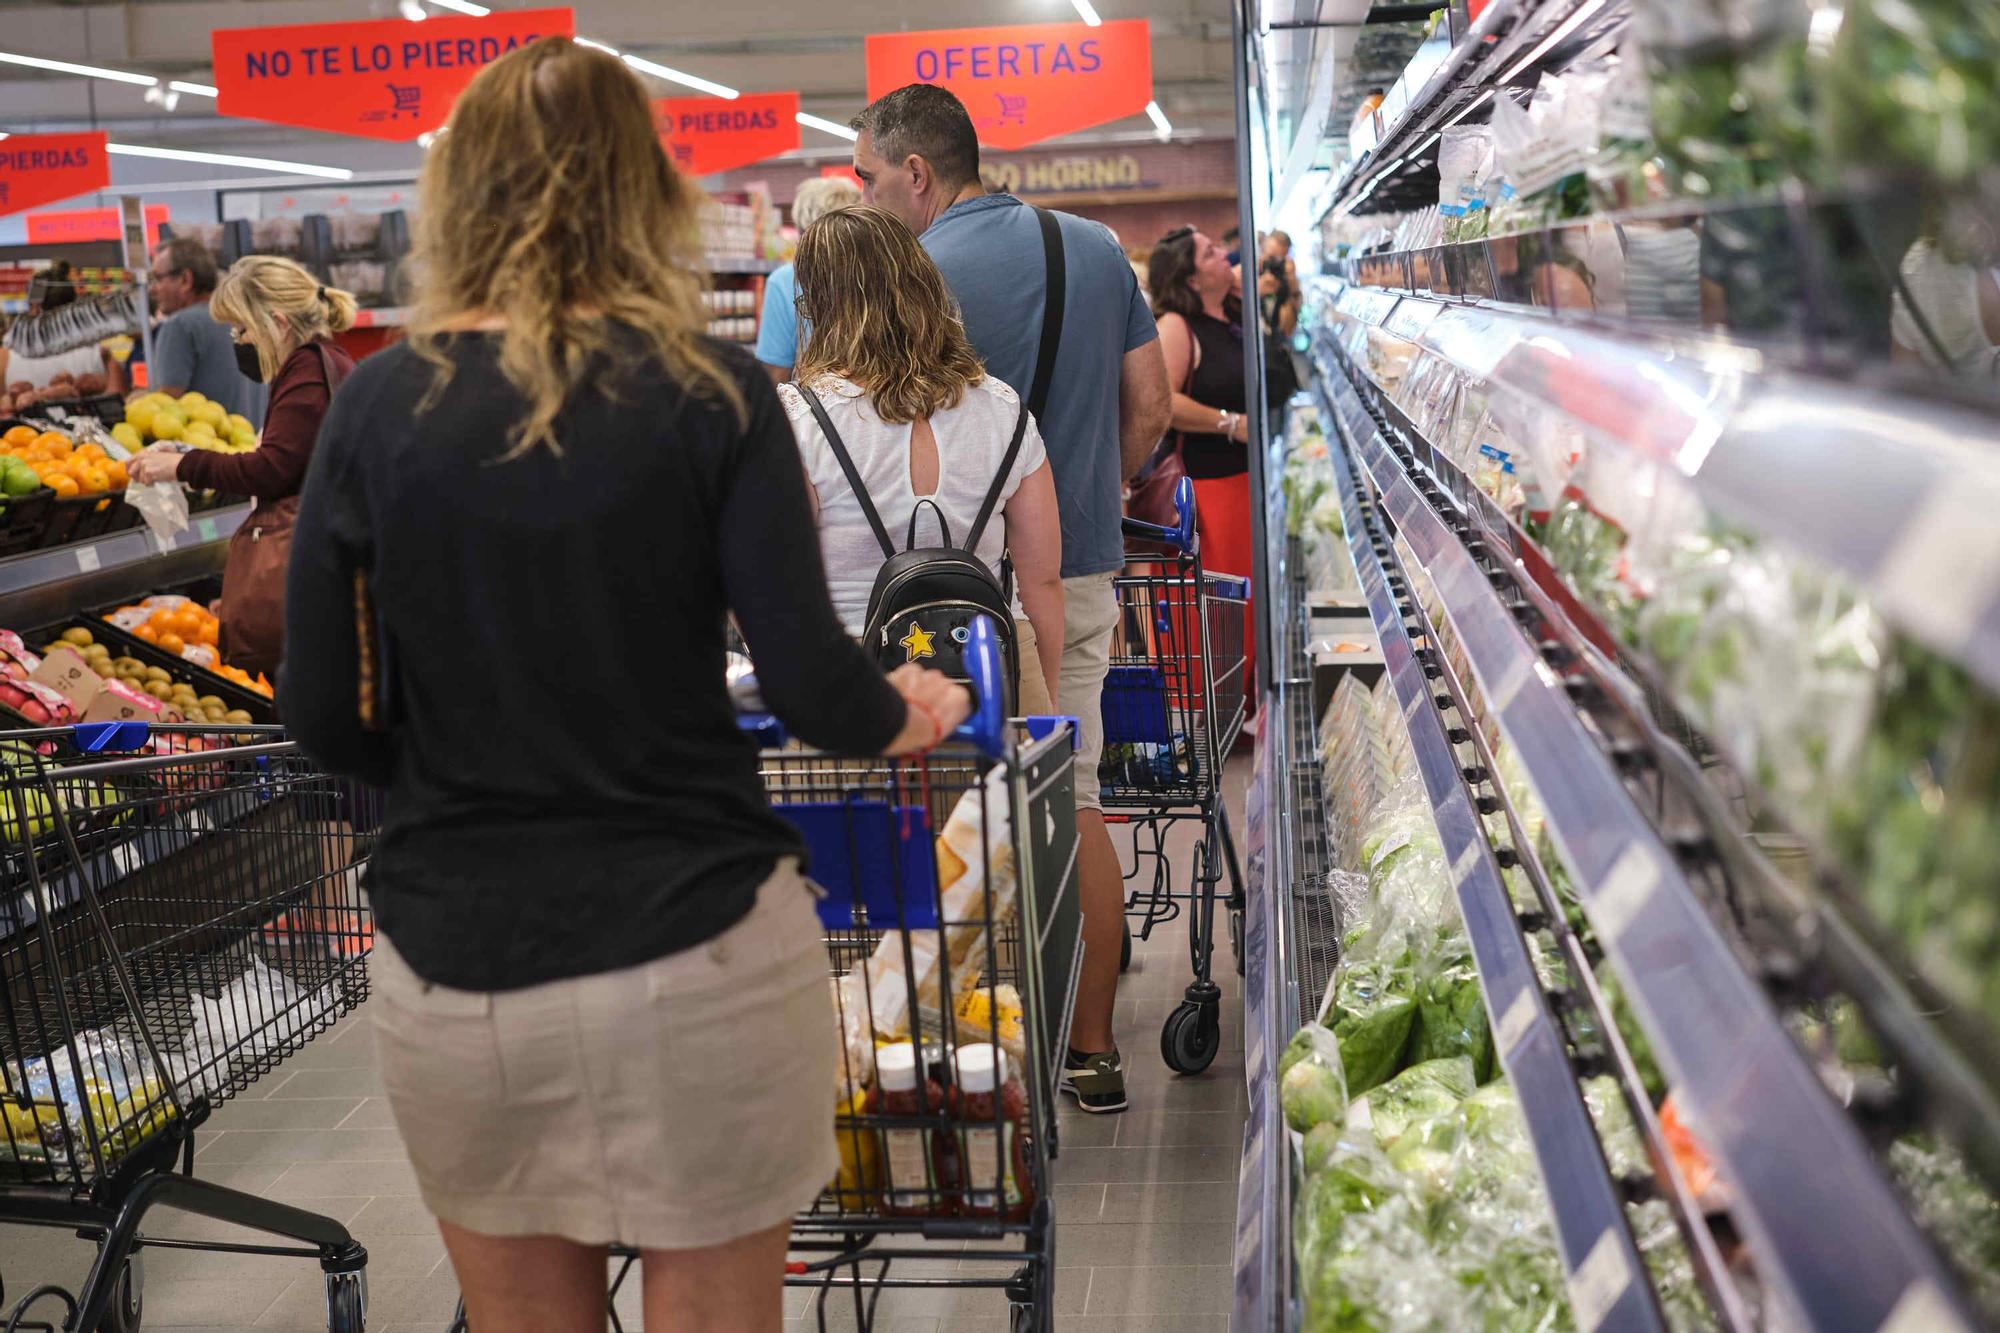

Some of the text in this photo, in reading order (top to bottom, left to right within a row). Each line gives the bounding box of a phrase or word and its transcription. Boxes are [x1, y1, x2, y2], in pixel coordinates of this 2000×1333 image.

[246, 51, 291, 78] NO
[303, 48, 340, 75] TE
[352, 44, 392, 72] LO
[915, 40, 1101, 81] OFERTAS
[680, 109, 777, 133] PIERDAS
[1026, 155, 1140, 191] HORNO
